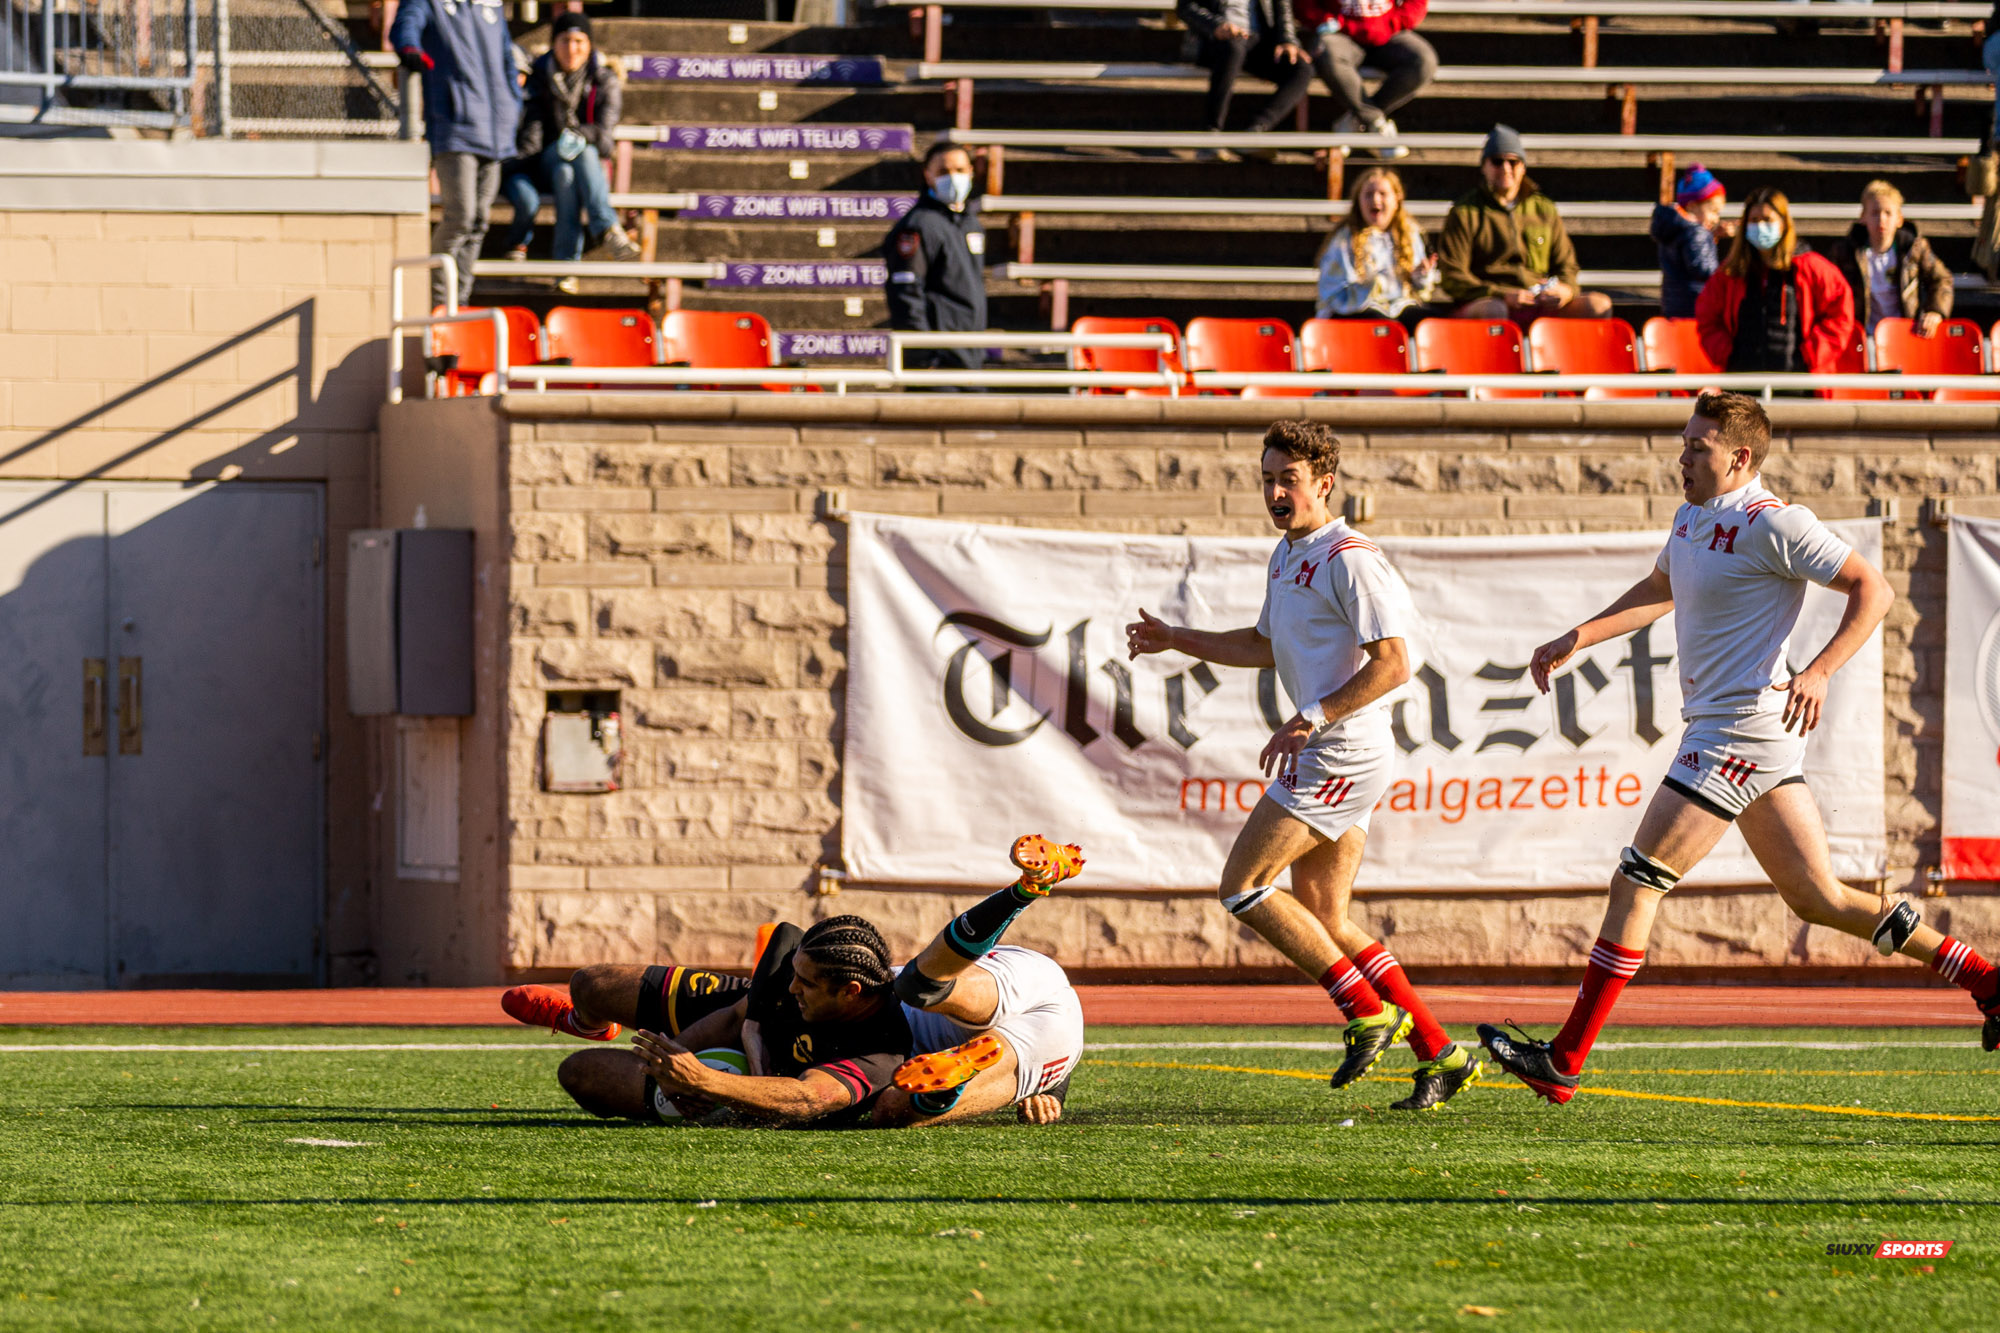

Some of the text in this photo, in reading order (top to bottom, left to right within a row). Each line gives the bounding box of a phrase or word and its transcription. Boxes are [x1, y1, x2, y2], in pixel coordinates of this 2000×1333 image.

[677, 58, 832, 79] ZONE WIFI TELUS
[705, 128, 860, 149] ZONE WIFI TELUS
[732, 197, 889, 217] ZONE WIFI TELUS
[762, 265, 816, 285] ZONE
[816, 265, 858, 285] WIFI
[791, 335, 887, 354] ZONE WIFI
[935, 610, 1223, 750] The
